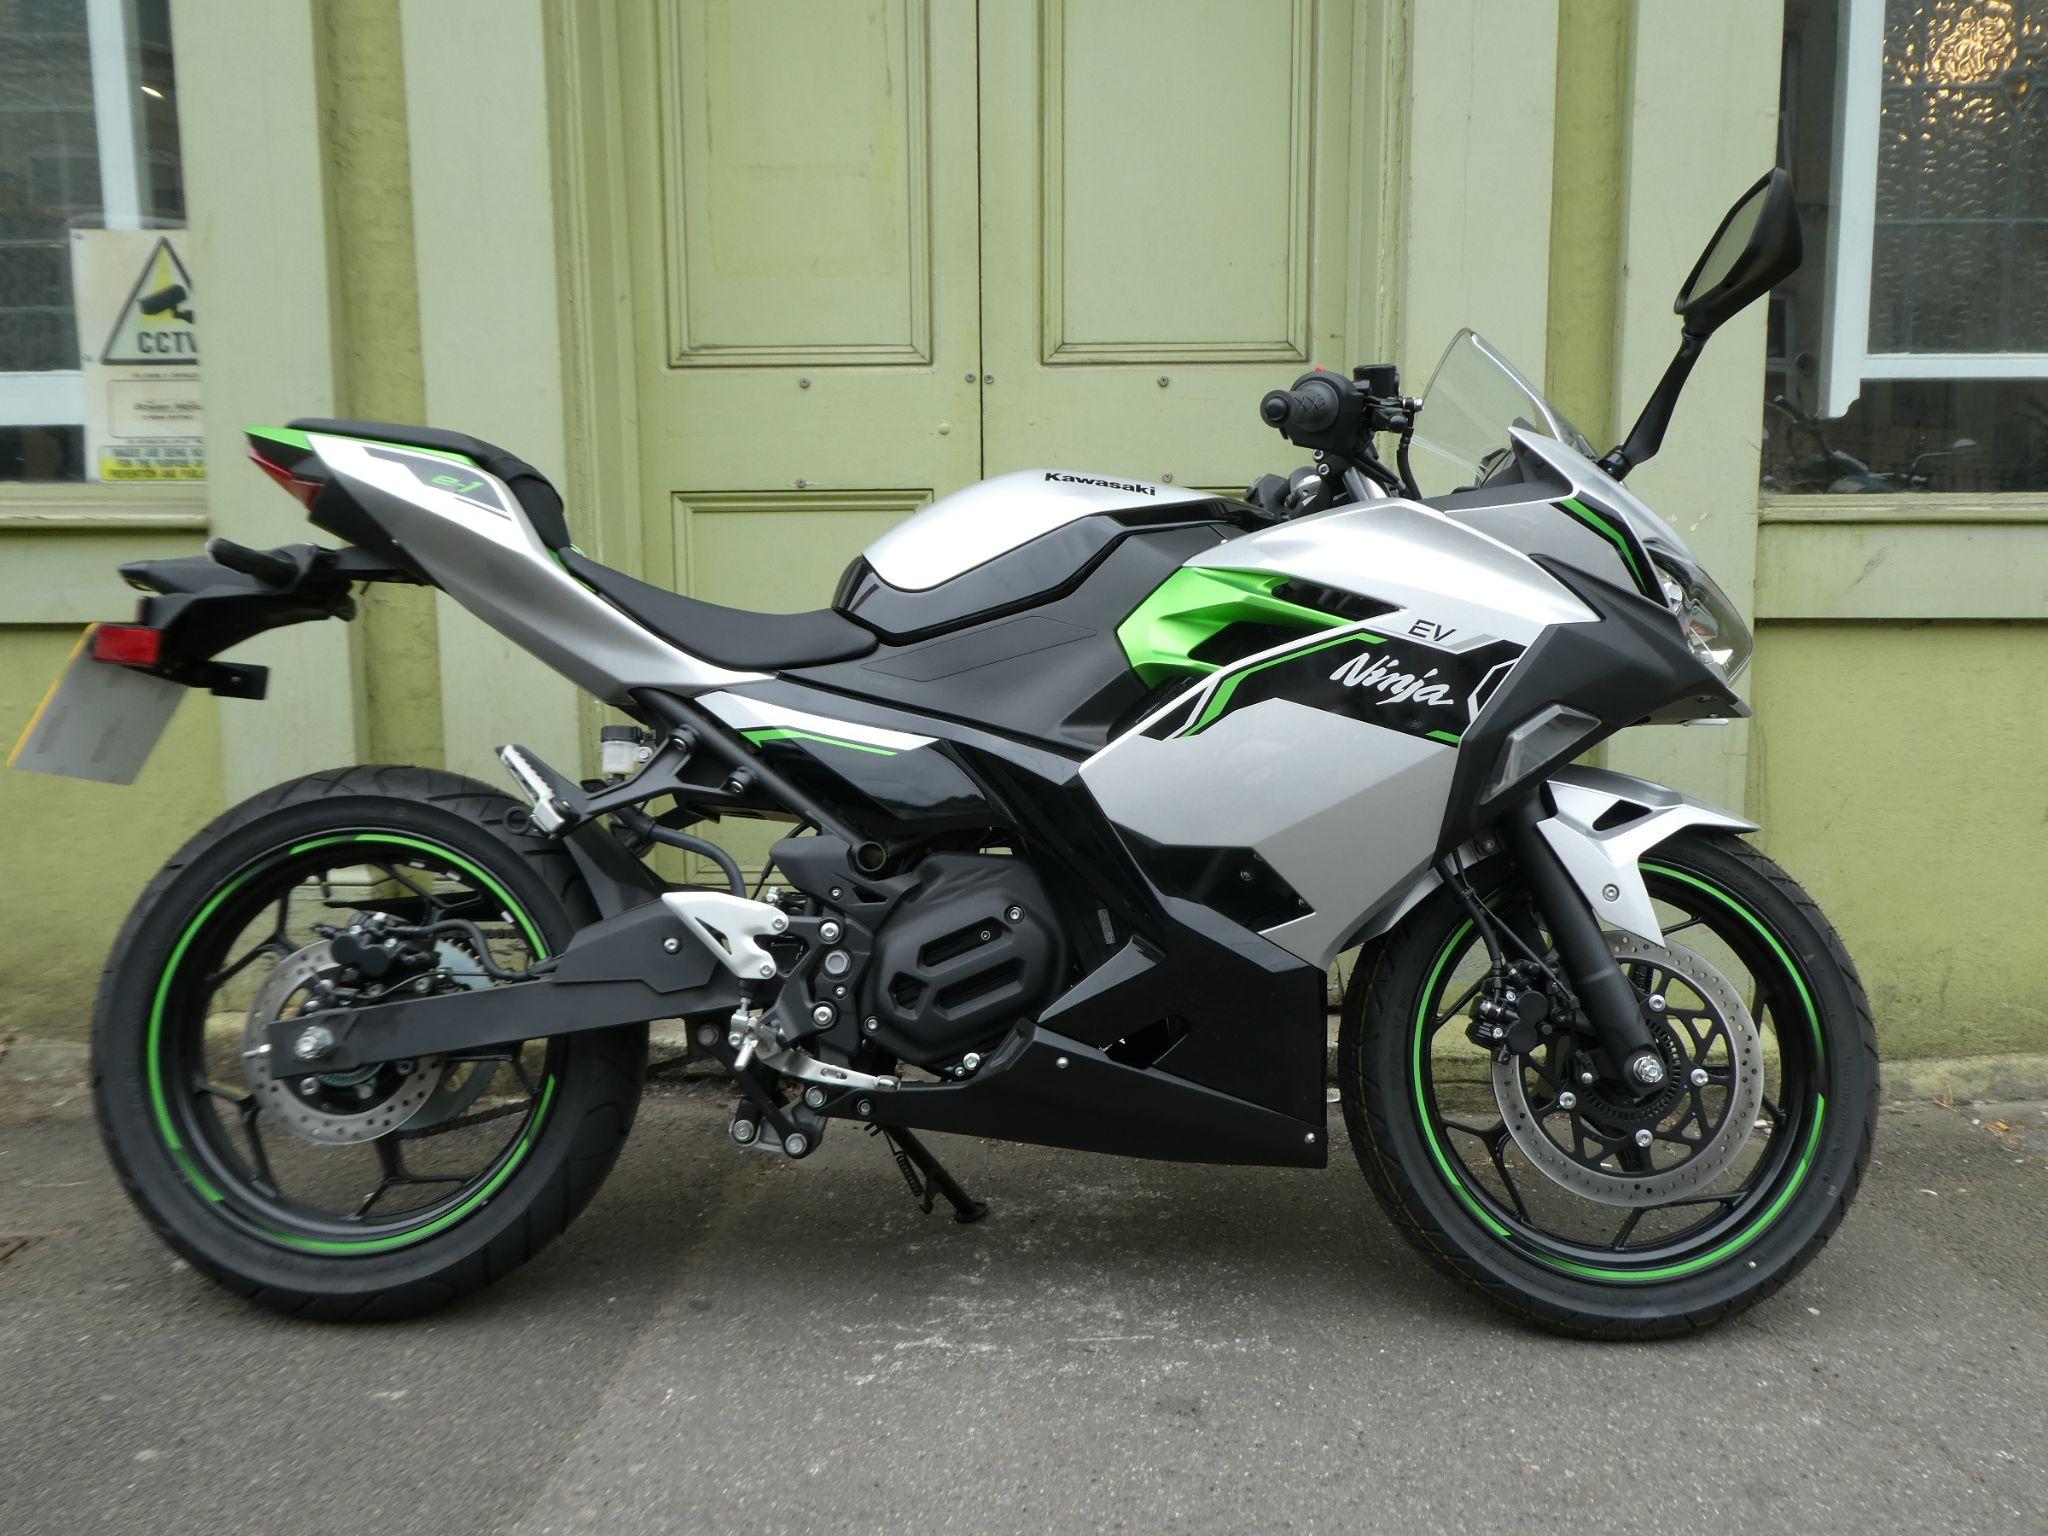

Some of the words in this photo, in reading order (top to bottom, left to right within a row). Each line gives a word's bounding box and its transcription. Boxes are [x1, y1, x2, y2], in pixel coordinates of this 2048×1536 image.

[1044, 472, 1156, 496] Kawasaki
[1408, 618, 1457, 642] EV
[1329, 652, 1454, 706] Ninja
